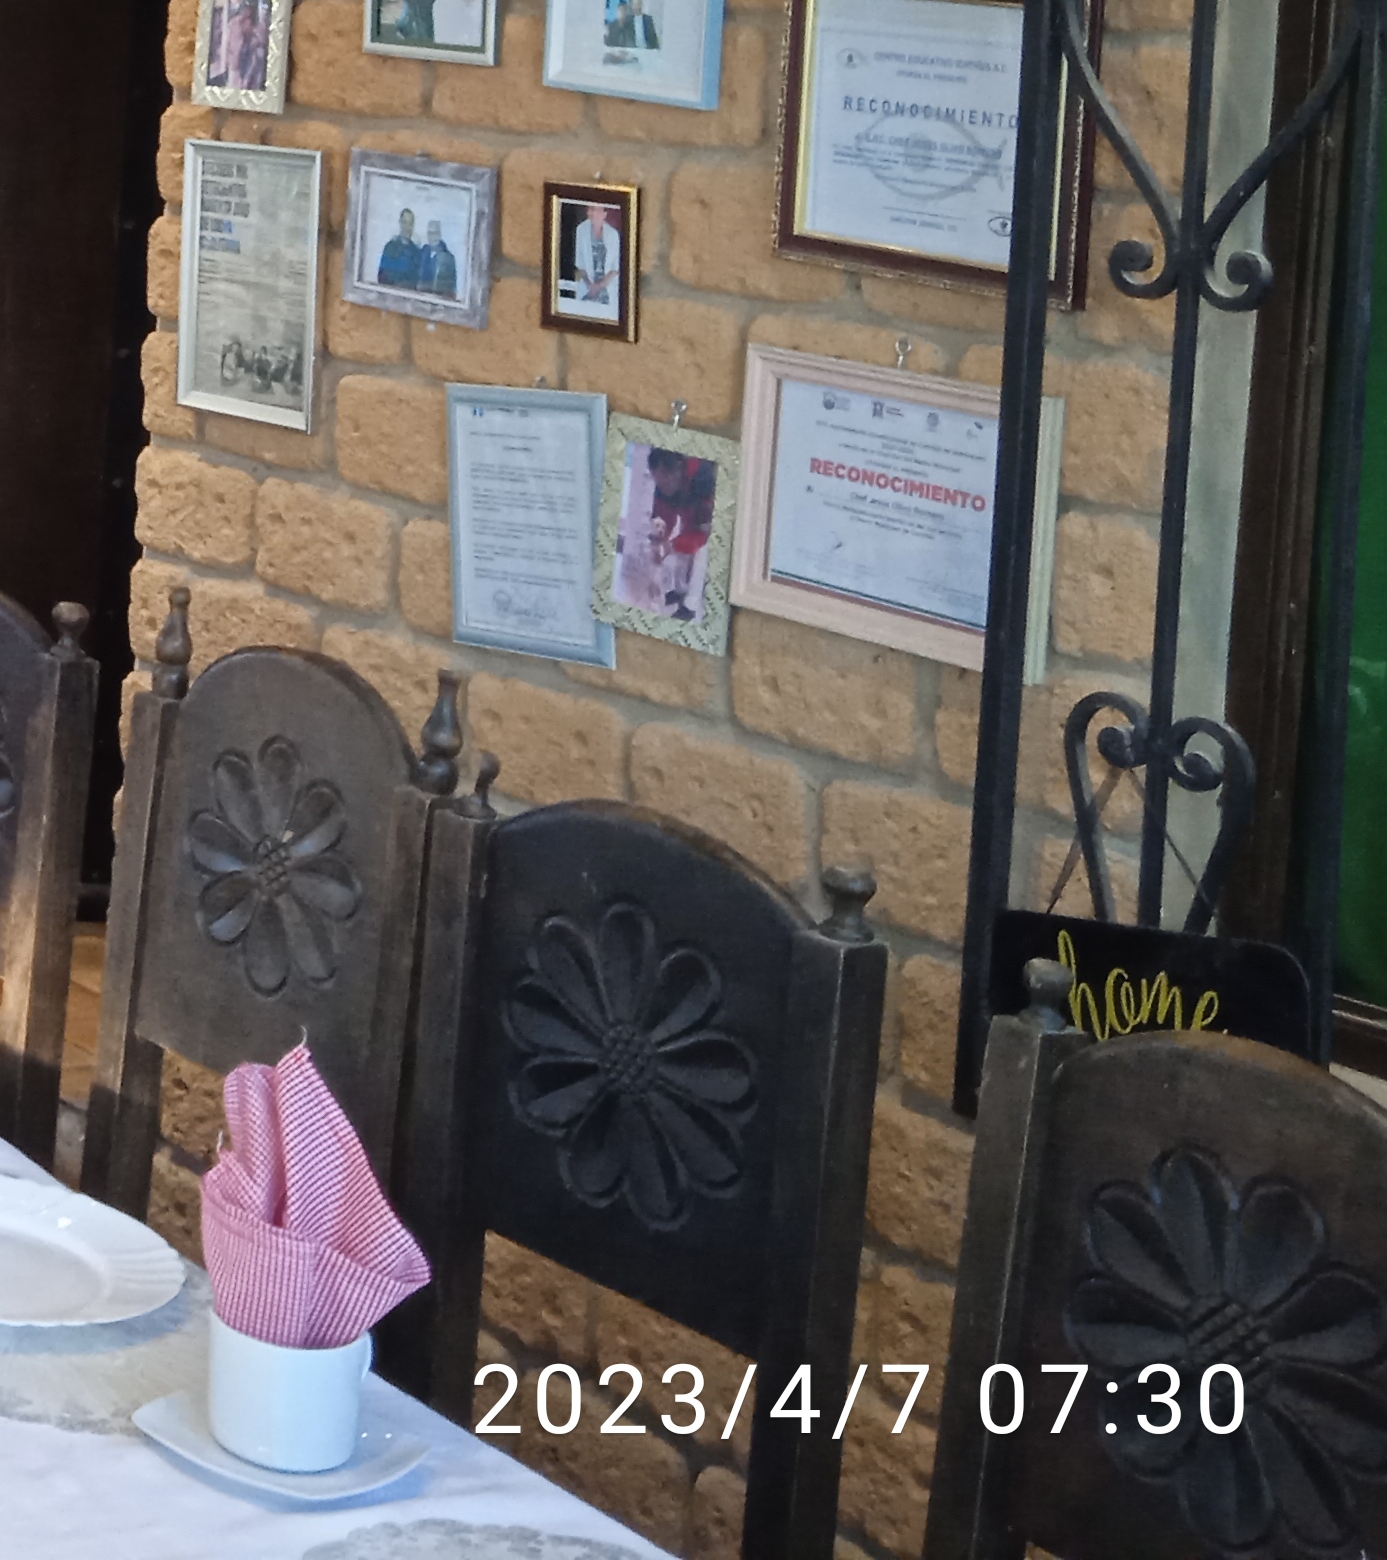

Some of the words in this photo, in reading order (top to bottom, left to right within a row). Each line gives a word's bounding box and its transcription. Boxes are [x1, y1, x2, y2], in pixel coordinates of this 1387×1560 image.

[842, 95, 1019, 129] RECONOCIMIENTO
[809, 457, 986, 512] RECONOCIMIENTO
[1057, 928, 1219, 1042] home
